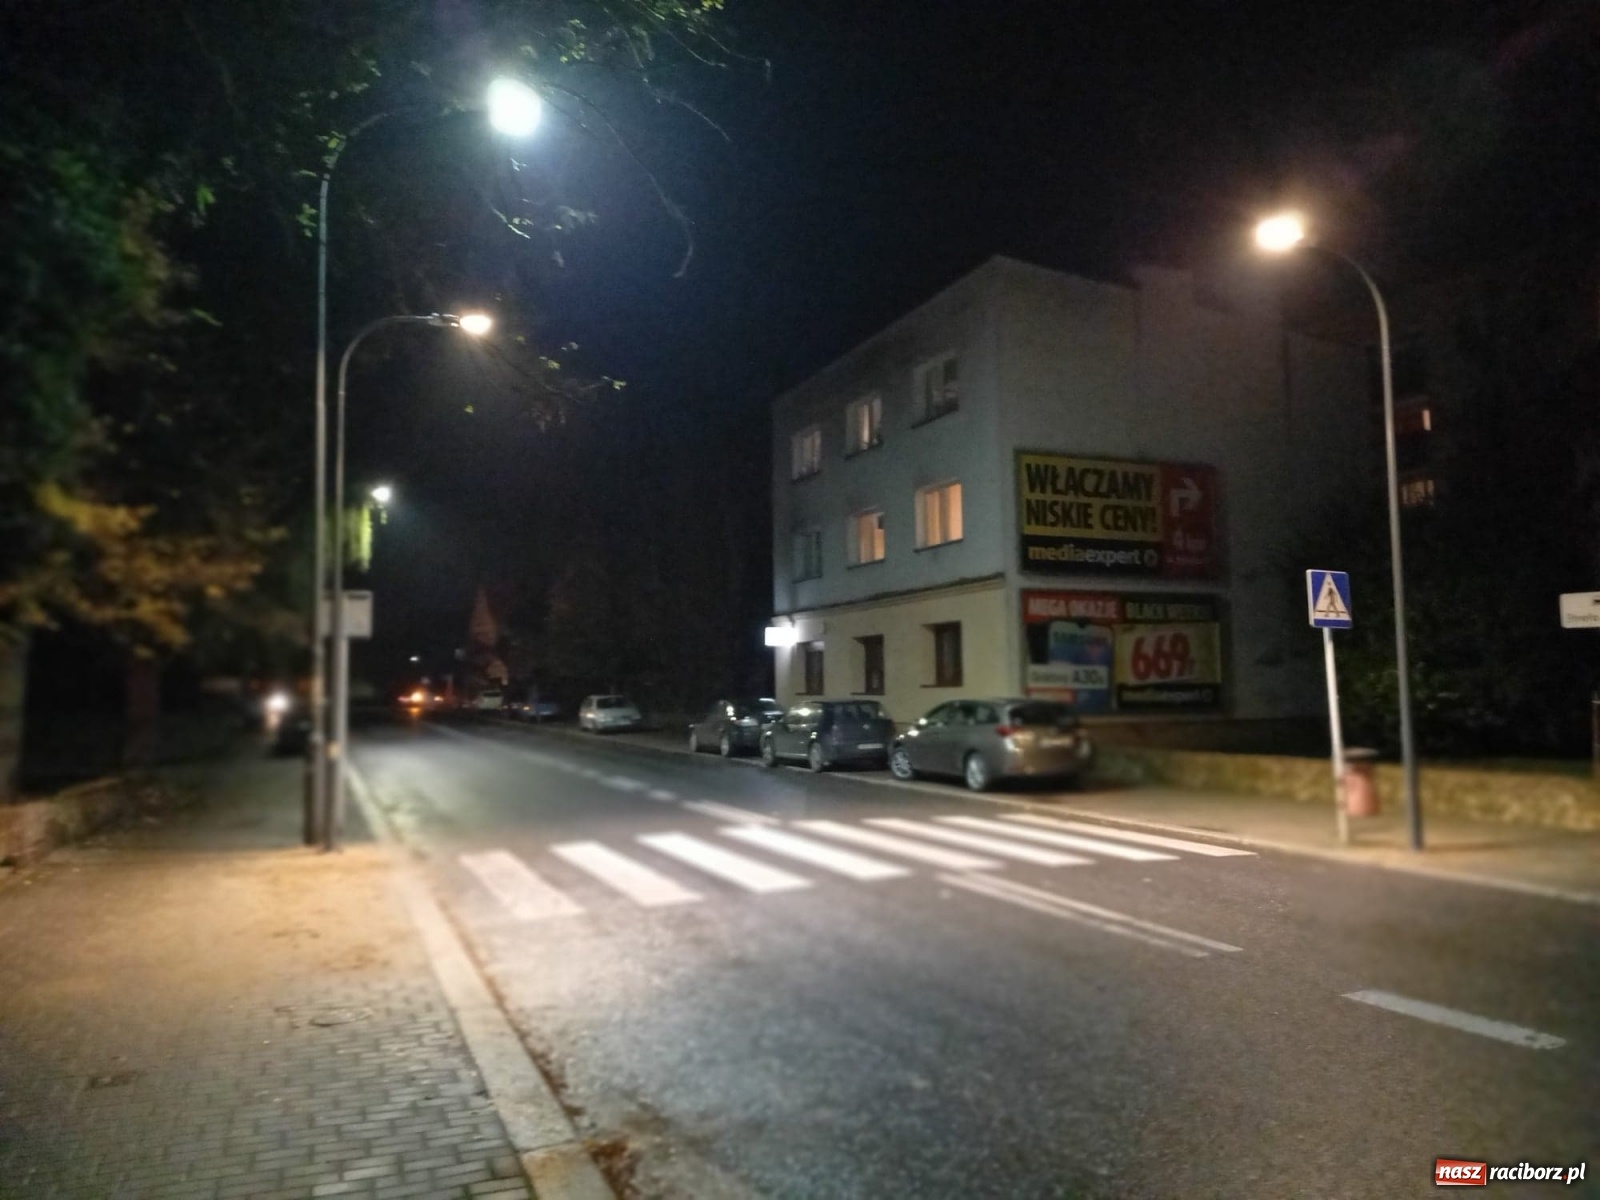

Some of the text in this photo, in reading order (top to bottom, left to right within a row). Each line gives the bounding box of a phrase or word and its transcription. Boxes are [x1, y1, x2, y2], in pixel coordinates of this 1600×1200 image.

[1025, 499, 1157, 533] NISKIE CENY!
[1028, 544, 1142, 567] mediaexpert
